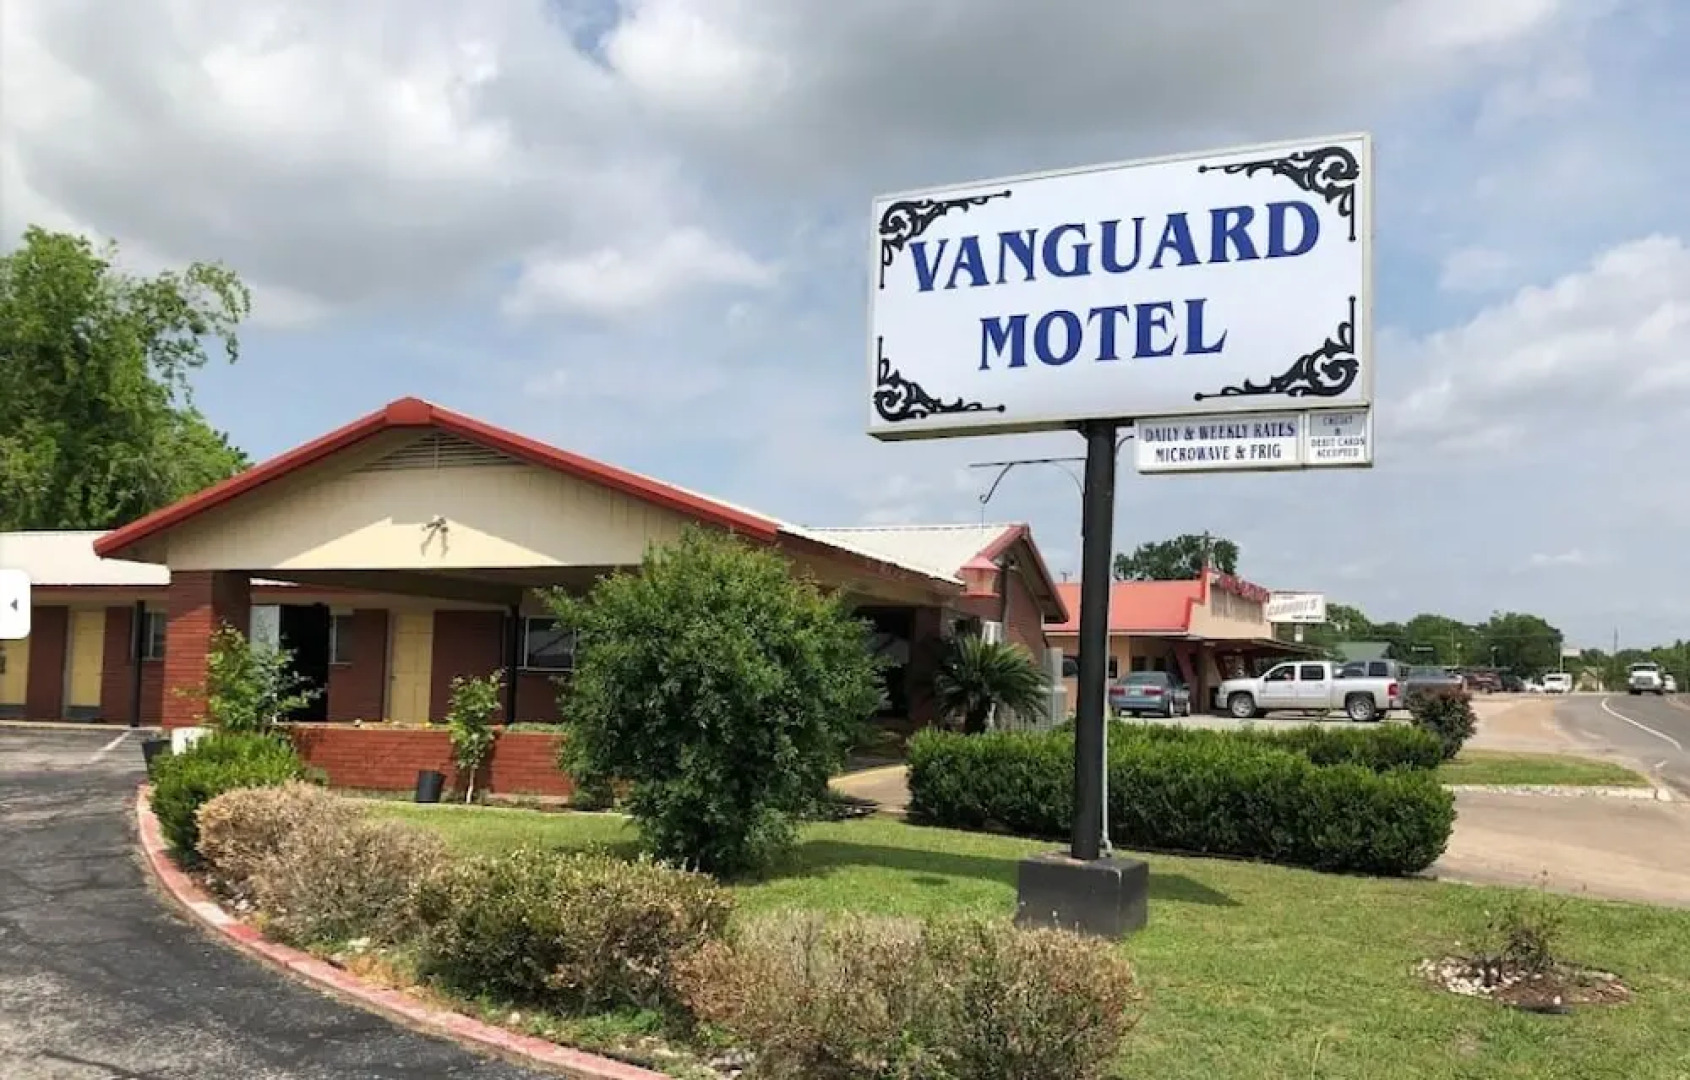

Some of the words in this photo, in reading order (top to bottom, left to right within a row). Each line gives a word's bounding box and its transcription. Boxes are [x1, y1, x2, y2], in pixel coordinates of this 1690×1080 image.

[909, 200, 1321, 292] VANGUARD
[978, 298, 1228, 371] MOTEL
[1145, 426, 1179, 442] DAILY
[1184, 426, 1195, 440] &
[1199, 423, 1248, 440] WEEKLY
[1253, 421, 1295, 438] RATES
[1156, 445, 1230, 462] MICROWAVE
[1235, 445, 1246, 460] &
[1250, 443, 1282, 459] FRIG
